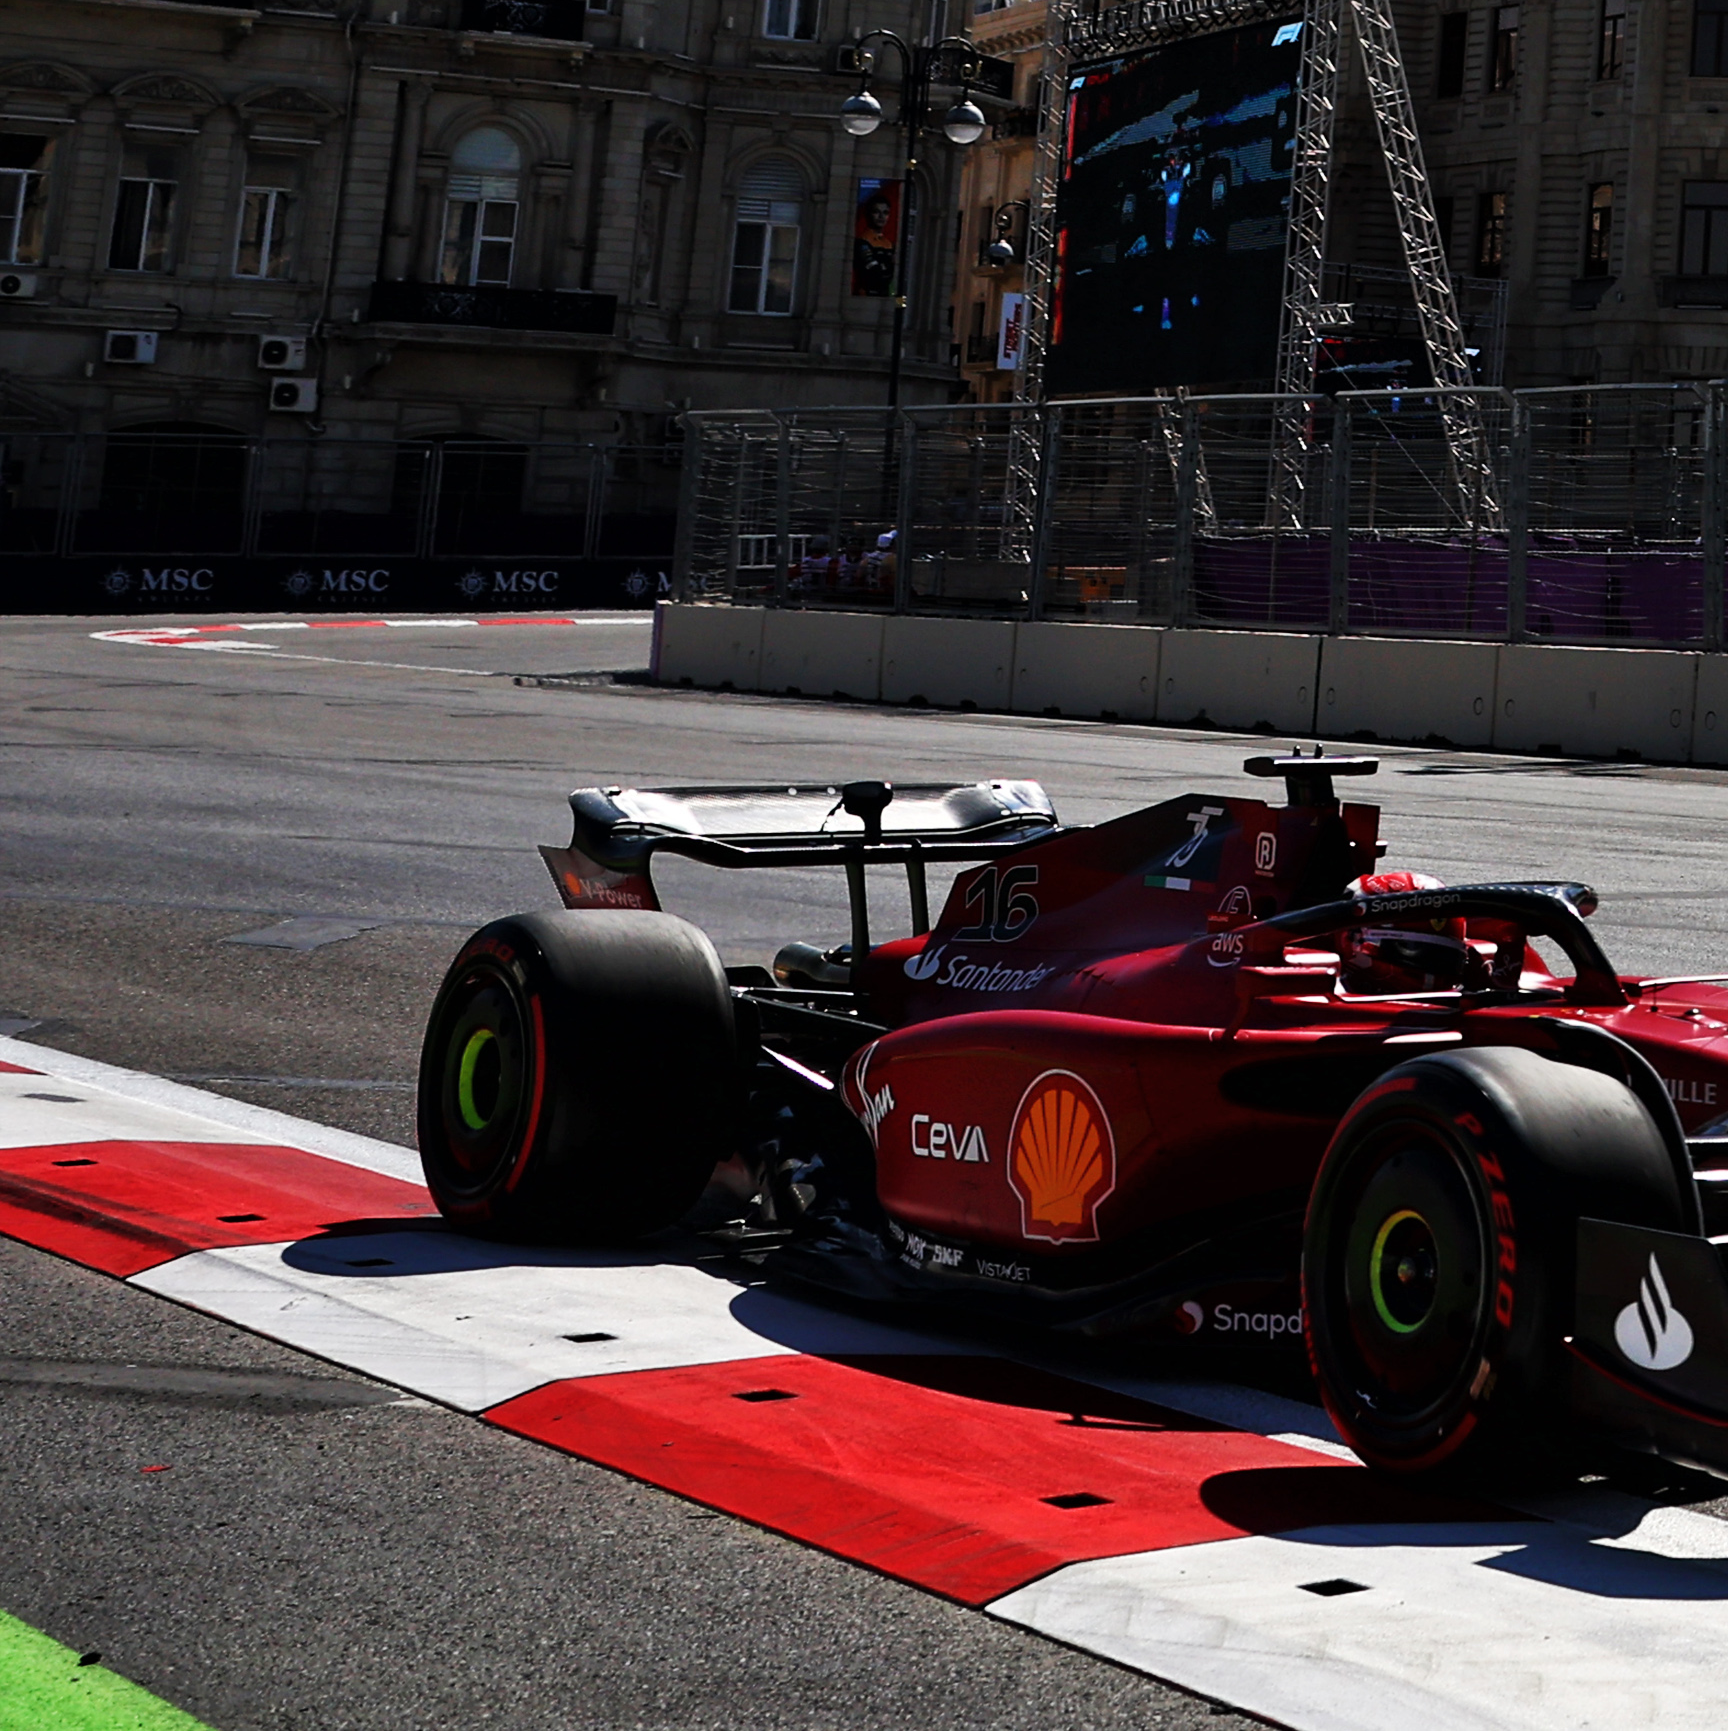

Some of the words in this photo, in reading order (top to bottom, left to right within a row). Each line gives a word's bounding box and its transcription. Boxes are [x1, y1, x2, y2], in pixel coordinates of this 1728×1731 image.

[139, 568, 215, 591] MSC
[319, 569, 390, 592] MSC
[492, 570, 559, 593] MSC
[579, 877, 643, 909] V-Power
[951, 864, 1039, 943] 16
[1371, 893, 1461, 913] Snapdragon
[1211, 932, 1245, 955] aws
[936, 955, 1056, 992] Santander
[1475, 1149, 1519, 1331] ZERO
[1213, 1303, 1304, 1340] Snapd
